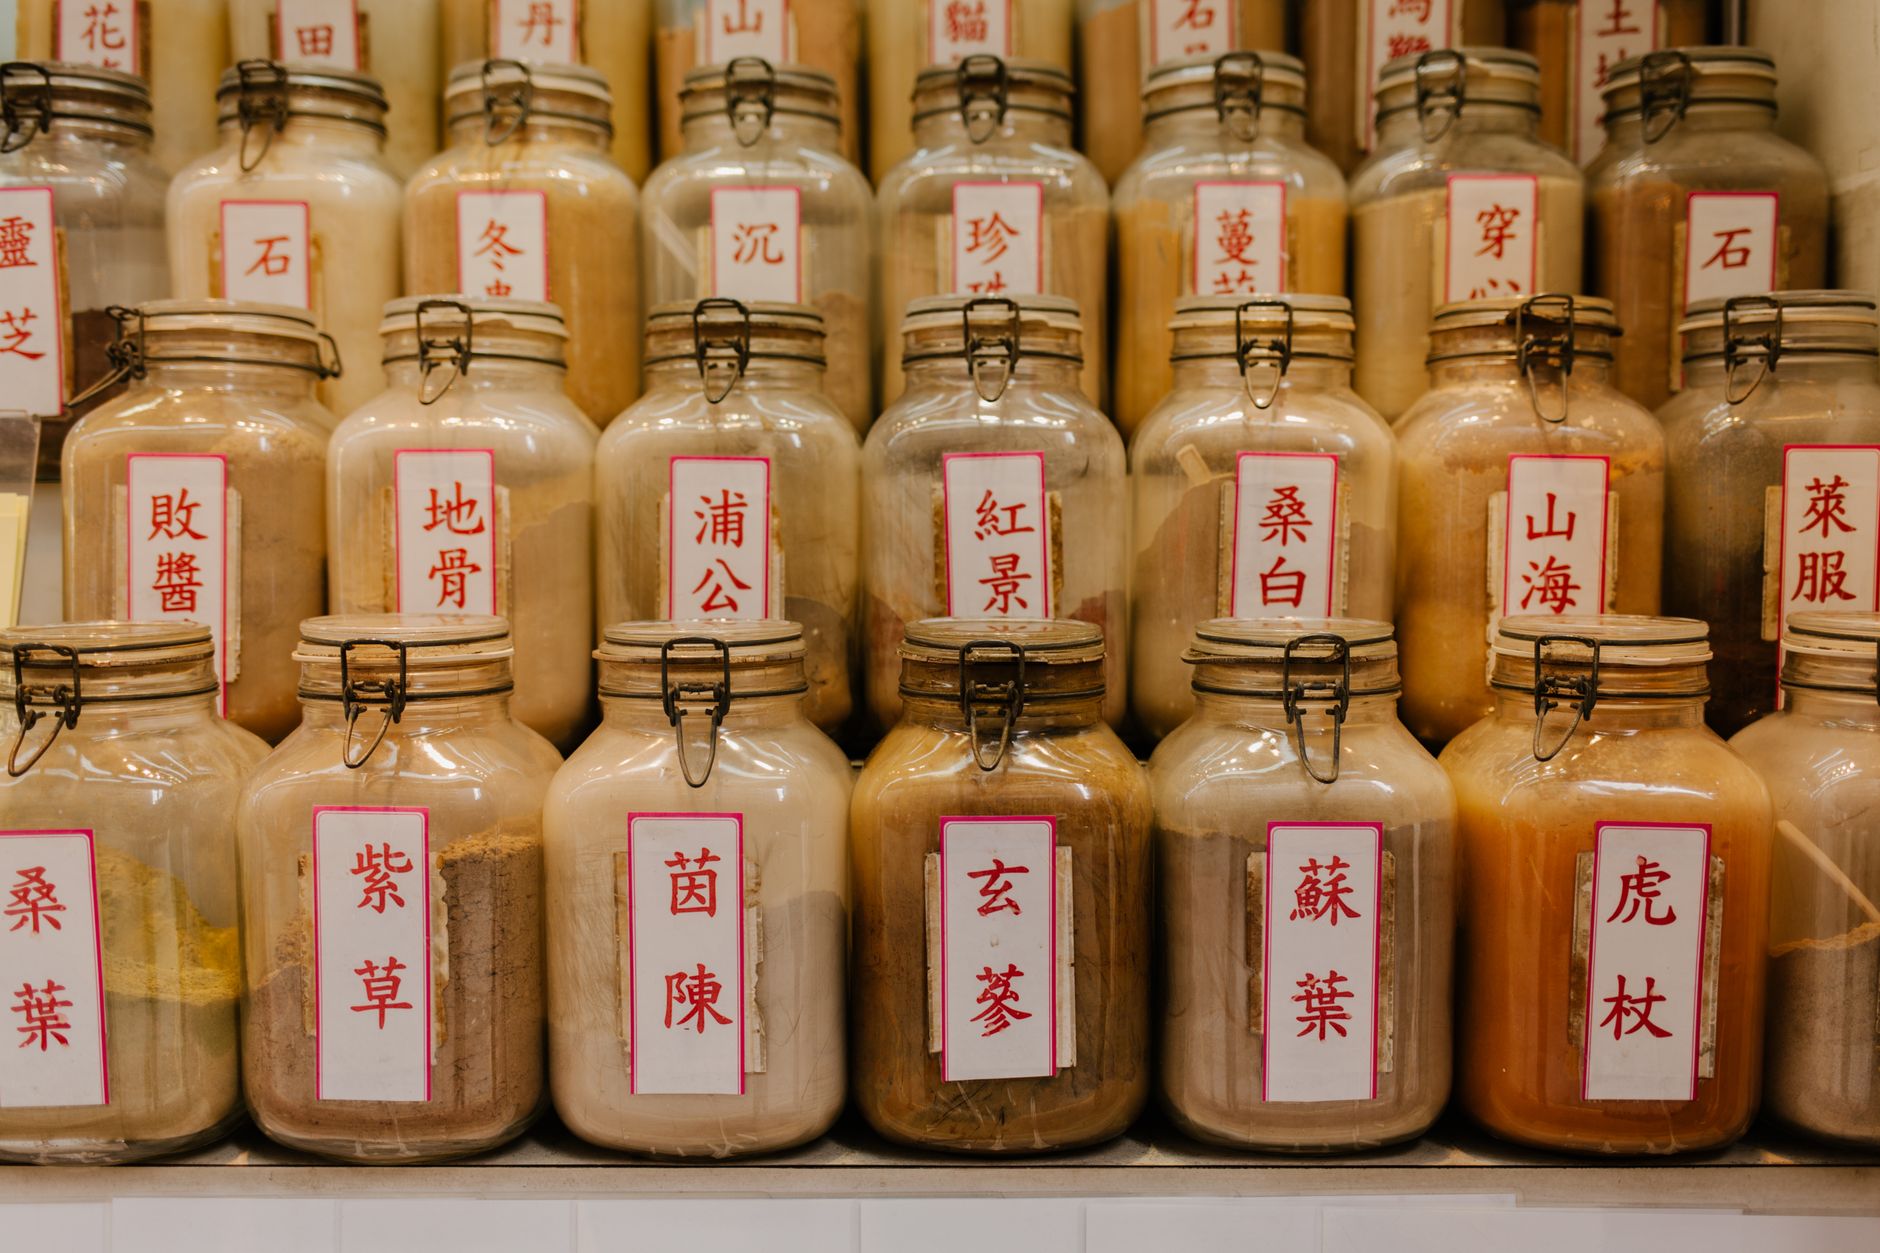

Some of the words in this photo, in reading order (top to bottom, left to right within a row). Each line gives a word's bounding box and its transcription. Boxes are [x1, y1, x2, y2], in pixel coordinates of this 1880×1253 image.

[81, 3, 126, 68] 花
[296, 23, 334, 56] 田
[516, 2, 564, 46] 丹
[723, 0, 764, 34] 山
[1172, 0, 1215, 55] 石
[0, 215, 46, 361] 靈芝
[246, 235, 291, 277] 石
[732, 223, 785, 265] 沉
[1701, 227, 1753, 271] 石
[147, 487, 208, 624] 敗醬
[423, 480, 486, 609] 地骨
[692, 488, 752, 613] 浦公
[975, 489, 1036, 614] 紅景
[1257, 485, 1313, 608] 桑白
[1519, 491, 1582, 614] 山海
[1790, 474, 1858, 604] 萊服
[3, 865, 74, 1052] 桑葉
[350, 842, 414, 1030] 紫草
[664, 847, 734, 1034] 茵陳
[1289, 854, 1362, 1041] 蘇葉
[1599, 855, 1678, 1041] 虎杖
